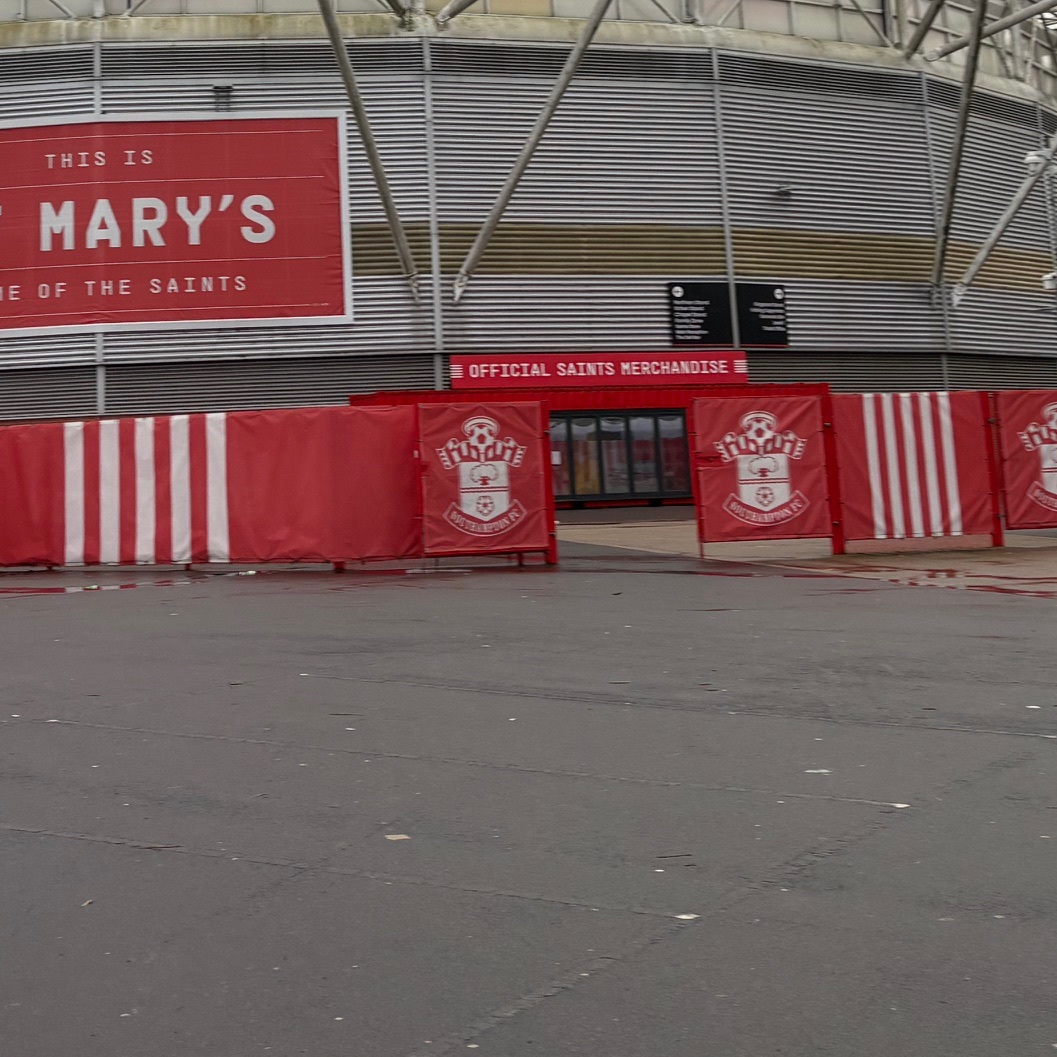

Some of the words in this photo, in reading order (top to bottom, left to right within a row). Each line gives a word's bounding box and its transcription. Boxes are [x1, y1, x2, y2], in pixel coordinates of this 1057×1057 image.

[44, 151, 106, 169] THIS
[123, 149, 153, 166] IS
[40, 194, 276, 252] MARY'S
[38, 282, 67, 299] OF
[84, 279, 131, 296] THE
[149, 275, 246, 294] SAINTS
[469, 363, 550, 378] OFFICIAL
[556, 361, 616, 376] SAINTS
[620, 360, 729, 376] MERCHANDISE
